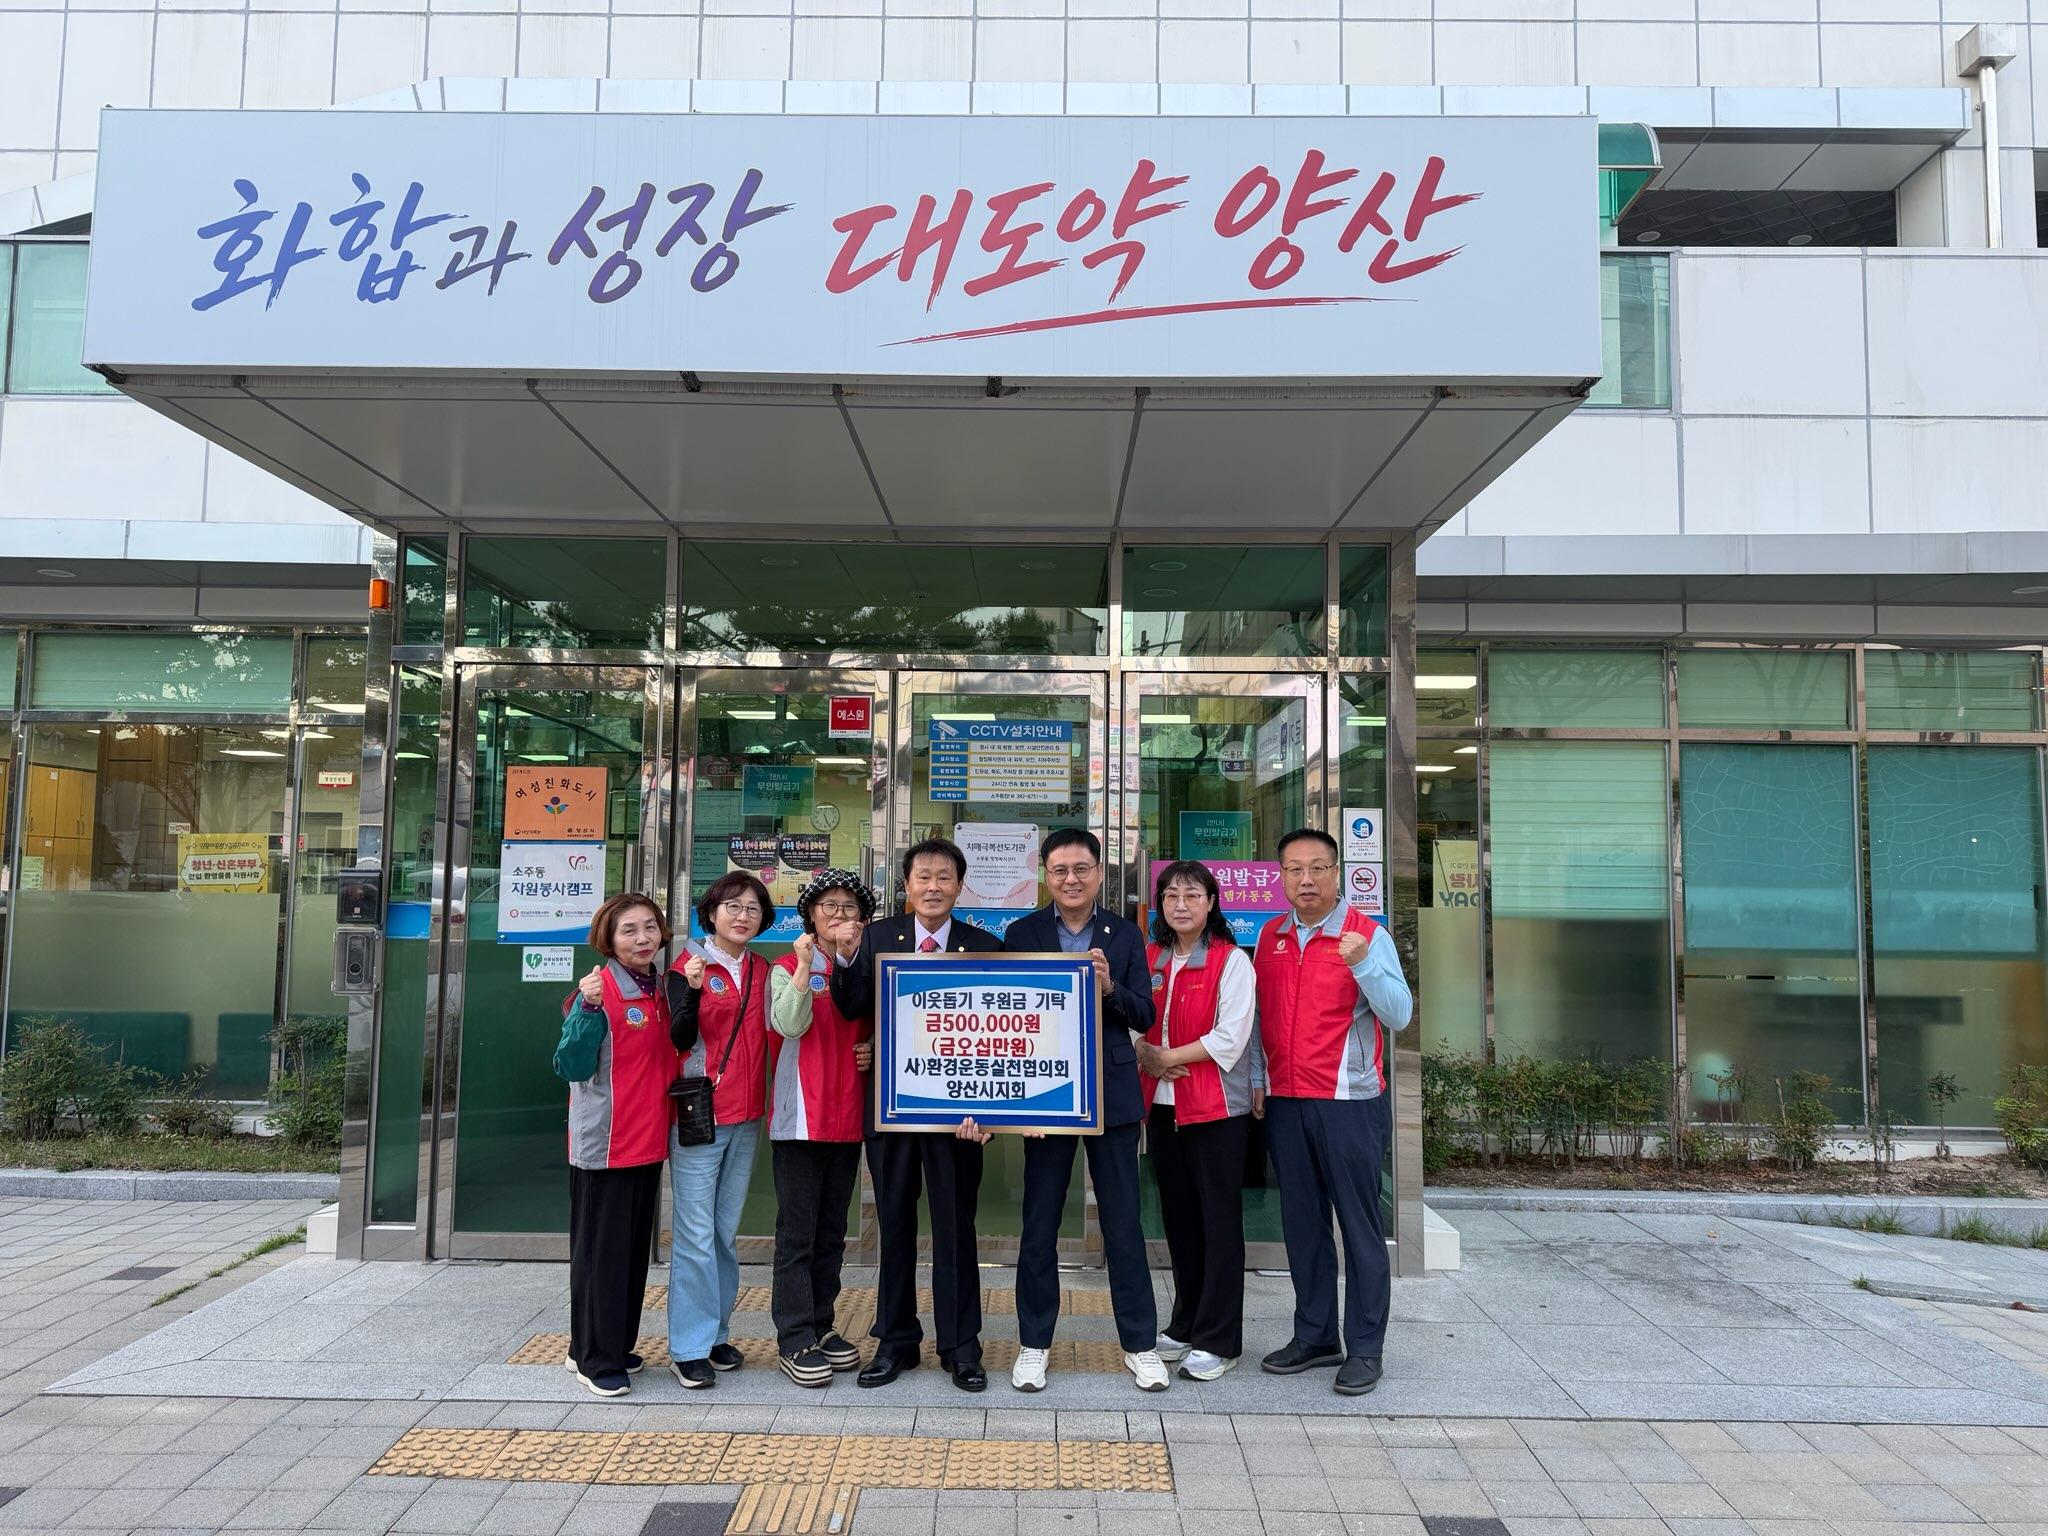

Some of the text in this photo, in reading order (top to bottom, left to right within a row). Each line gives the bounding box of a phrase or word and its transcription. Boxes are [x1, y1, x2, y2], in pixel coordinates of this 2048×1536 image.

[191, 150, 1484, 311] 화합과 성장 대도약 양산
[836, 709, 865, 721] 에스원
[969, 725, 1062, 738] CCTV설치안내
[515, 777, 597, 802] 여성친화도시
[757, 781, 800, 791] 무인발급기
[1194, 827, 1238, 837] 무인발급기
[966, 842, 1026, 853] 치매극복선도기관
[512, 866, 546, 878] 소주동
[511, 882, 594, 898] 자원봉사캠프
[1218, 889, 1274, 903] 템가동중
[1351, 894, 1378, 902] 금연구역
[911, 991, 1067, 1010] 이웃돕기 후원금 기탁
[925, 1013, 1041, 1034] 금500,000원
[931, 1037, 1035, 1057] (금오십만원)
[904, 1058, 1069, 1078] 사)환경운동실천협의회
[946, 1080, 1026, 1100] 양산시지회
